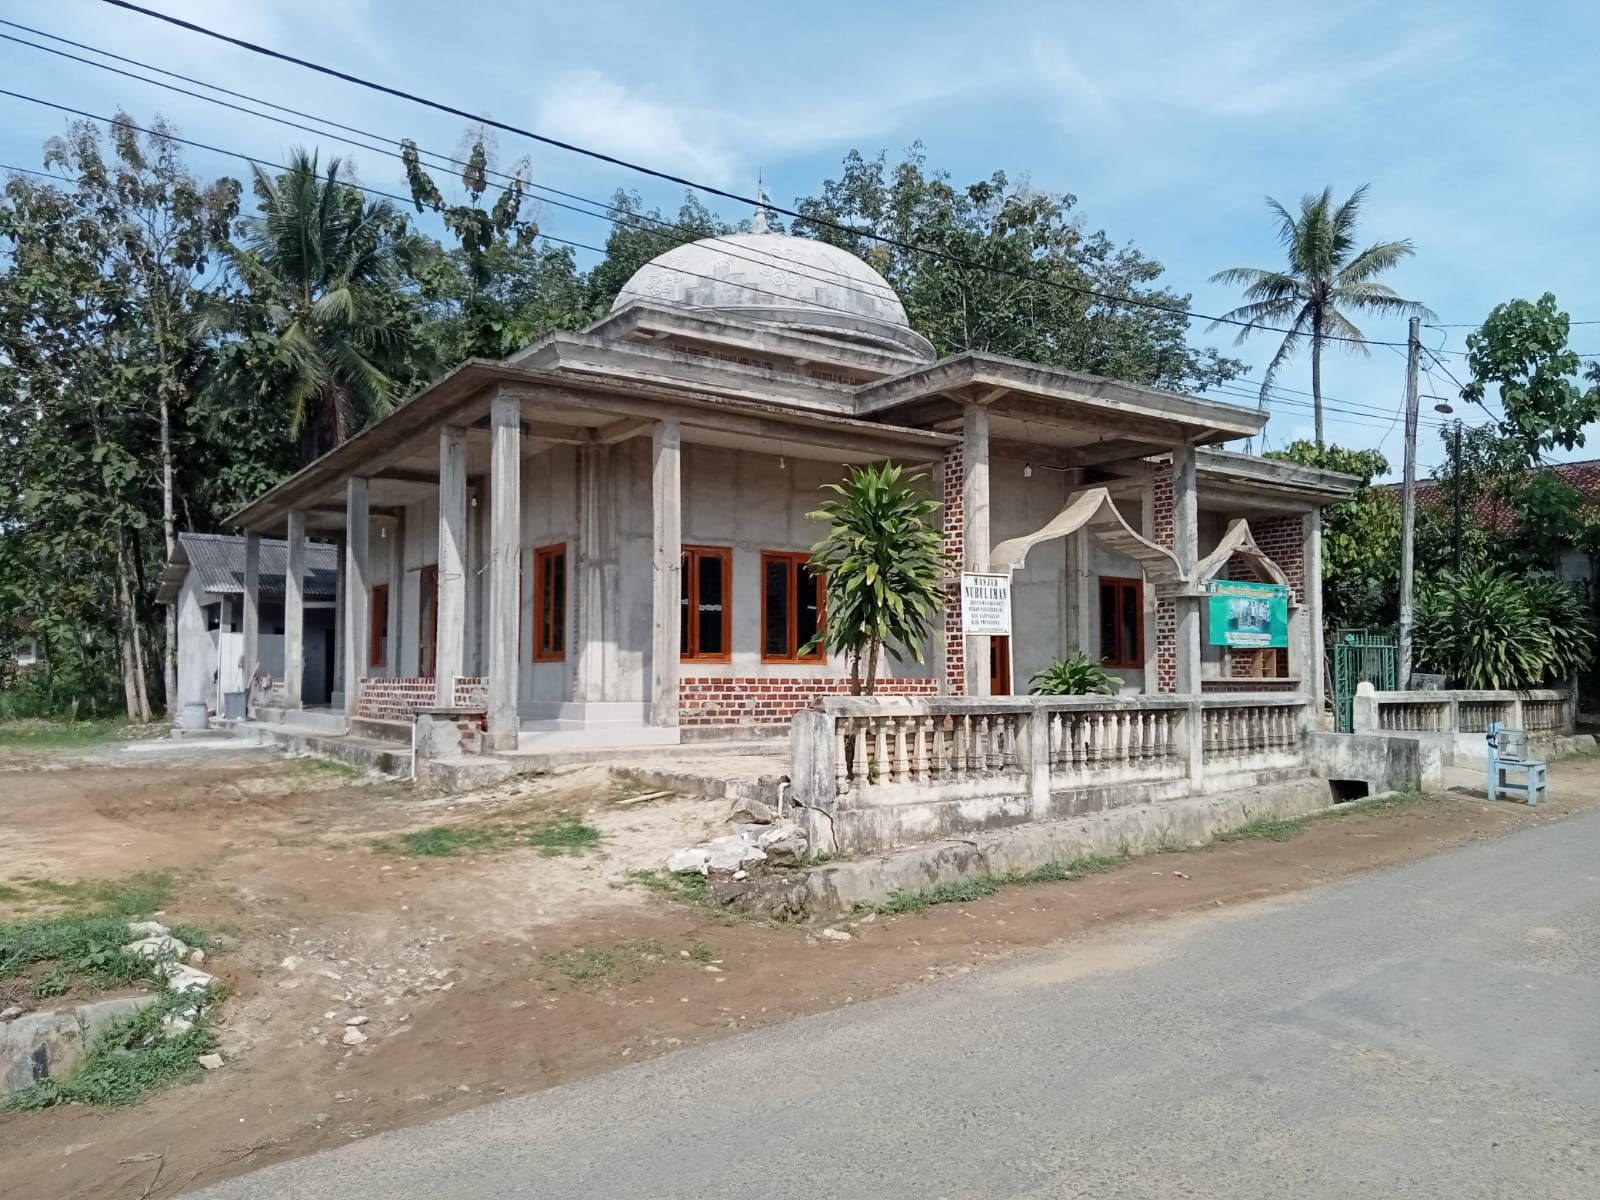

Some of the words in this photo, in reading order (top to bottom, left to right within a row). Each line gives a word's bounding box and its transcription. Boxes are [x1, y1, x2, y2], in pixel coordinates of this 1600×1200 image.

[974, 577, 998, 587] MASJID
[965, 586, 988, 599] NURUL
[989, 587, 1007, 600] IMAN
